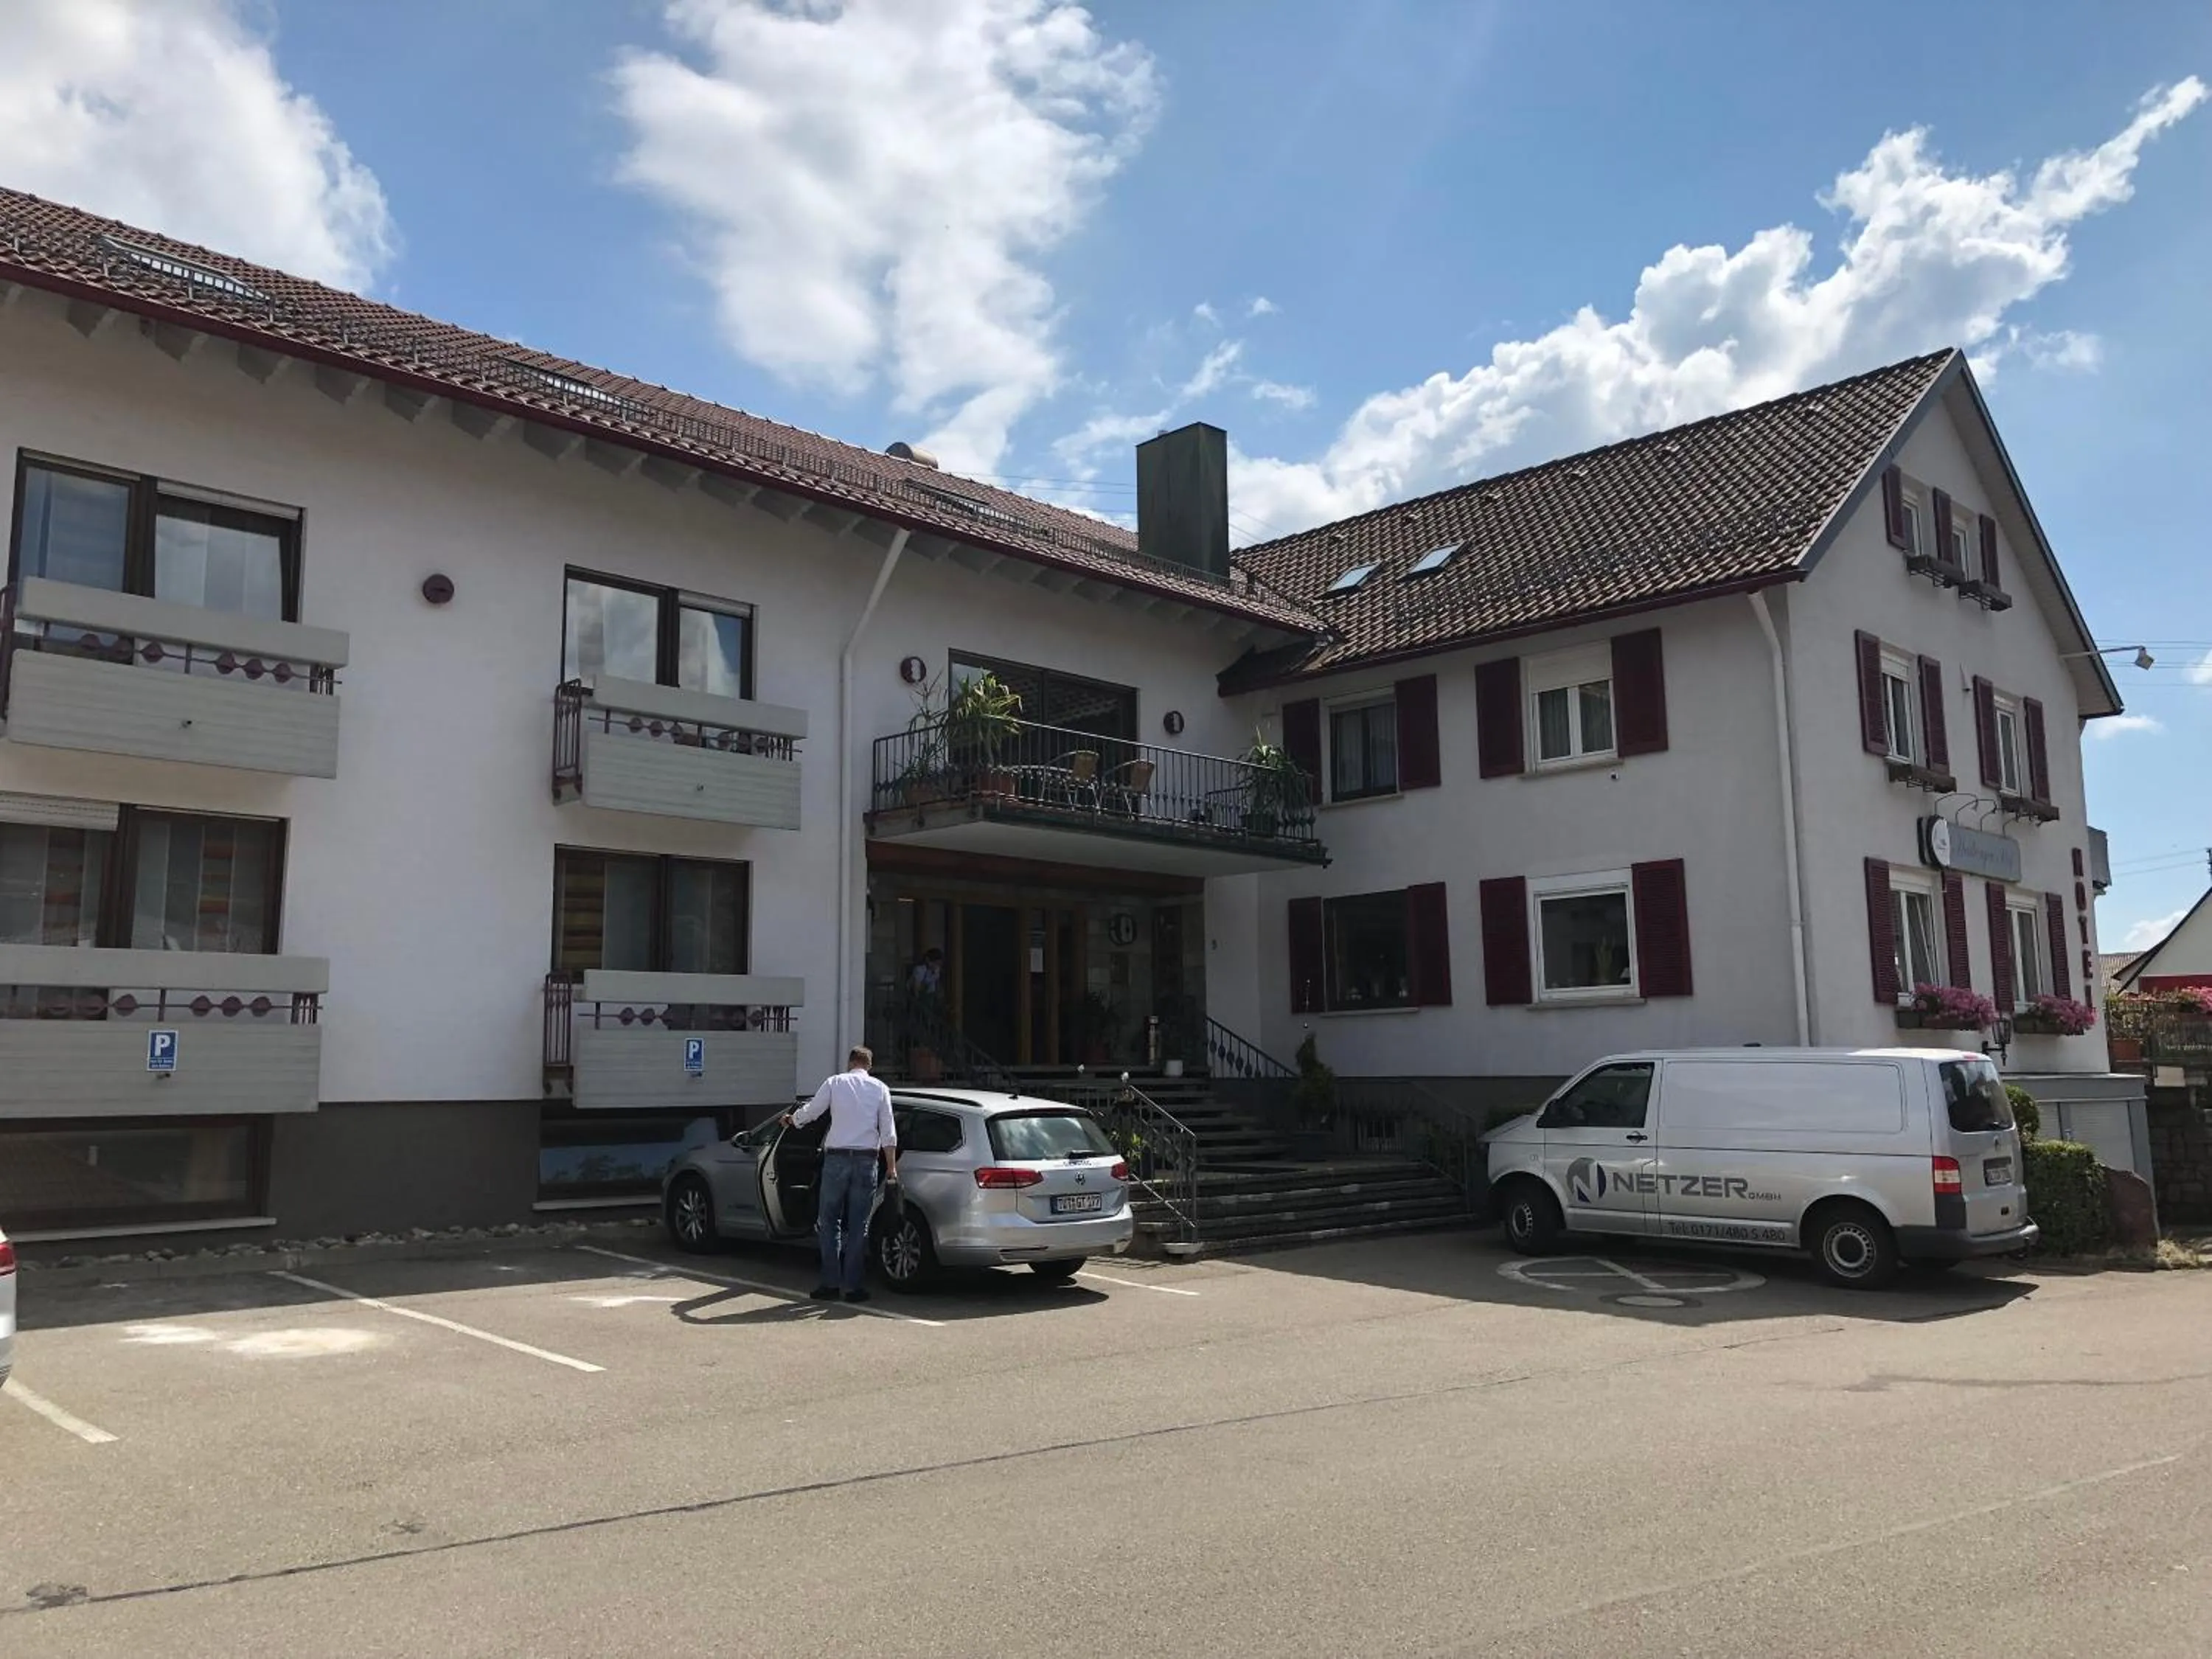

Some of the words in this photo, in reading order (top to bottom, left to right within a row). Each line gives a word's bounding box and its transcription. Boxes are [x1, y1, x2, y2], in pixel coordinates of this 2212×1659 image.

[155, 1034, 170, 1056] P
[689, 1040, 700, 1059] P
[1613, 1172, 1748, 1199] NETZER
